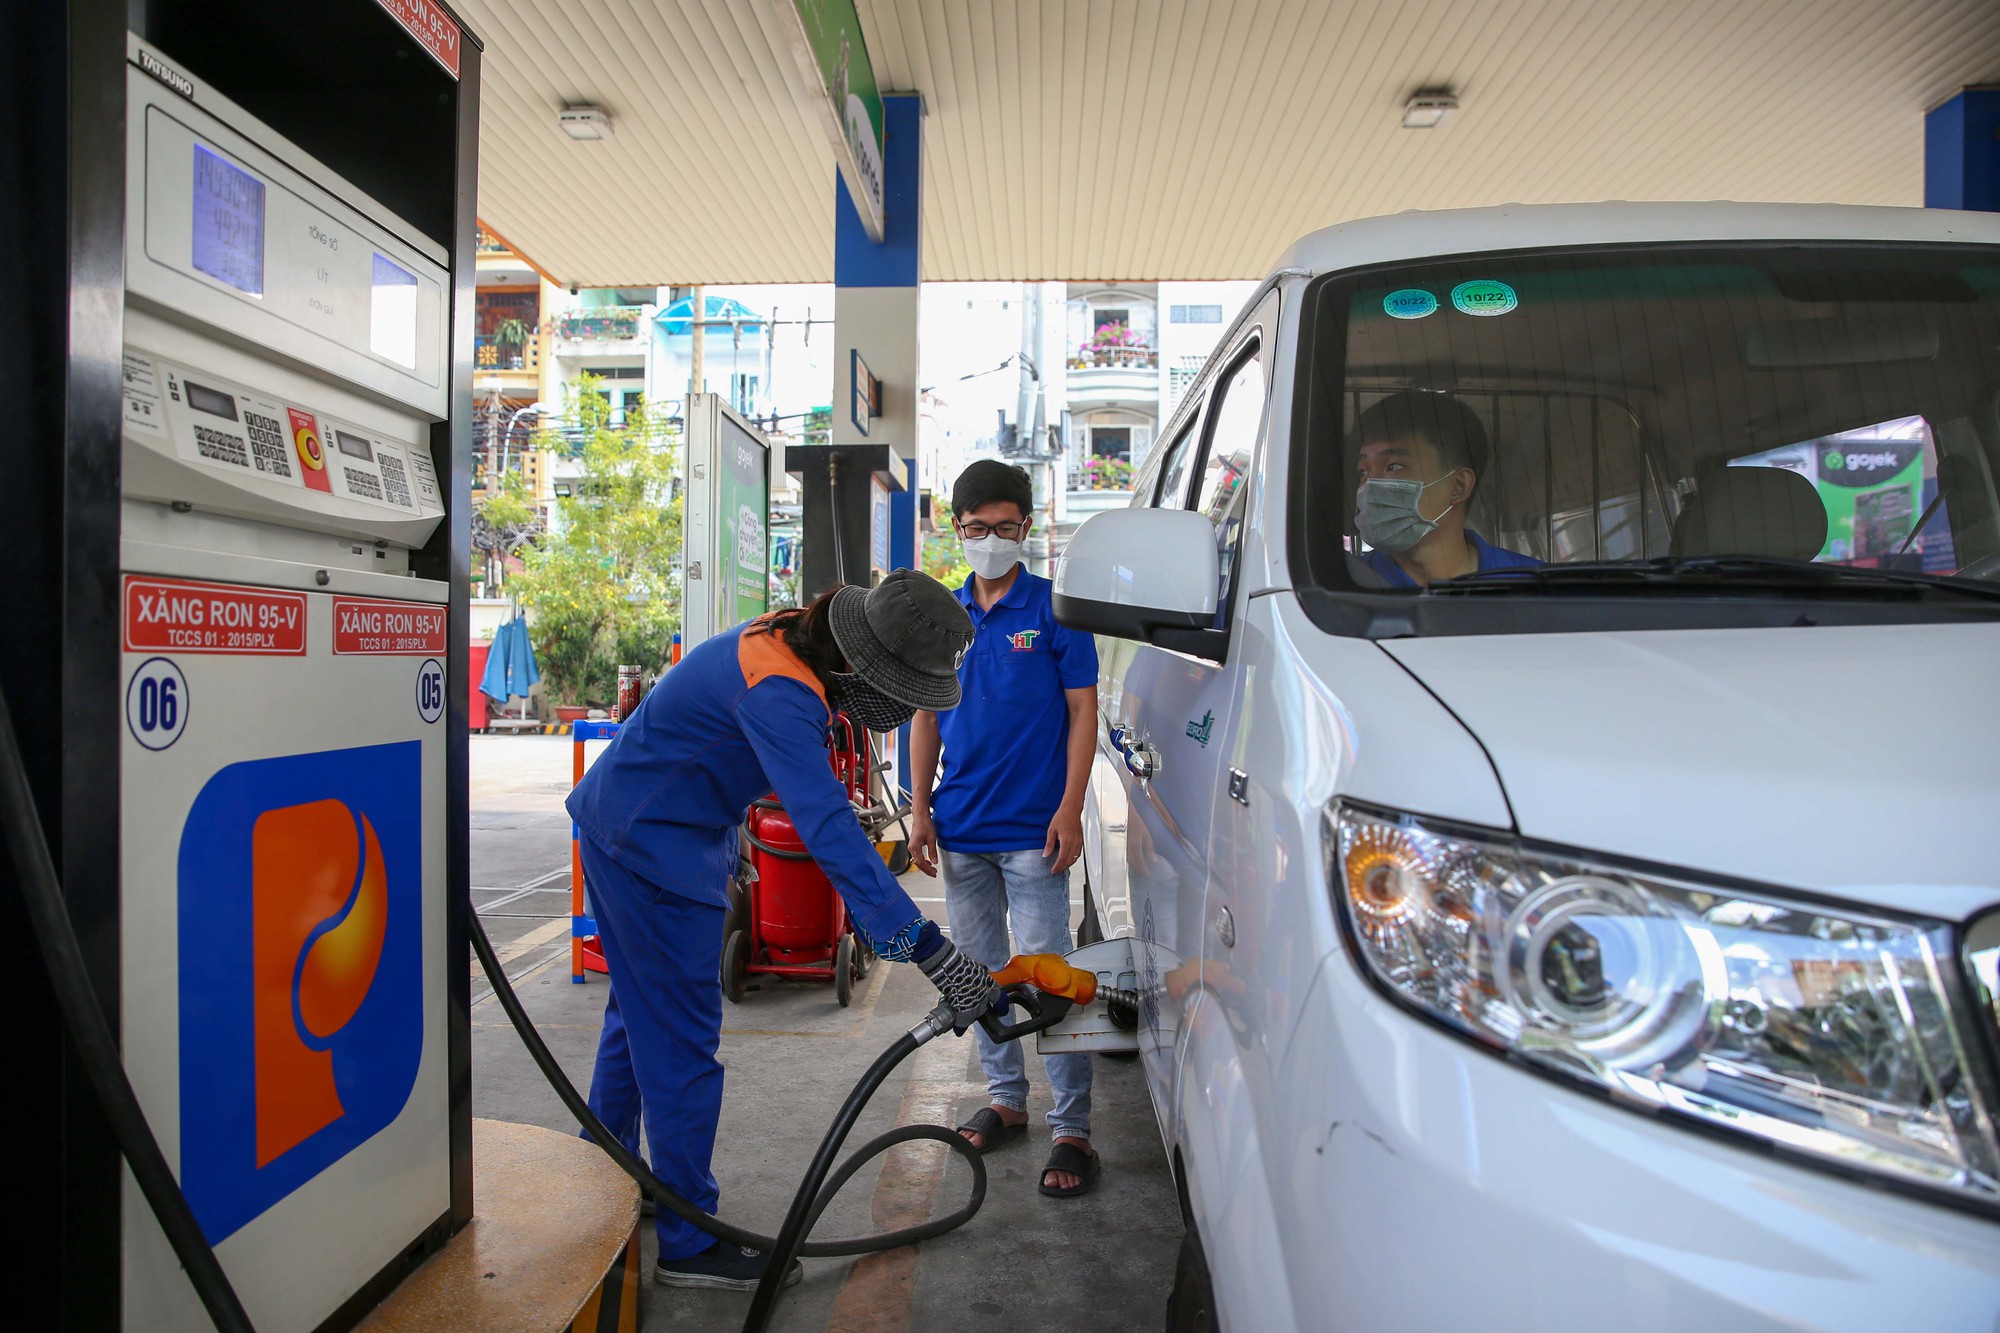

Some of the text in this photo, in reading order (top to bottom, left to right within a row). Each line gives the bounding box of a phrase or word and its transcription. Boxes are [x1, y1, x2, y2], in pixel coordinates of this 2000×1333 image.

[396, 2, 405, 17] 01
[411, 16, 441, 54] 2015/PLX
[430, 13, 455, 50] 95-V
[141, 52, 192, 95] TATSUNO
[1392, 297, 1426, 307] 10/22
[1466, 292, 1504, 302] 10/22
[738, 446, 754, 470] gojek
[1845, 450, 1898, 471] gojek
[138, 590, 297, 630] XĂNG RON 95-V
[341, 607, 441, 635] XĂNG RON 95-V
[169, 630, 201, 646] TCCS
[205, 632, 217, 646] 01
[228, 633, 274, 647] 2015/PLX
[359, 638, 380, 650] TCCS
[382, 638, 390, 650] 01
[397, 638, 427, 650] 2015/PLX
[140, 677, 177, 732] 06
[421, 673, 441, 710] 05
